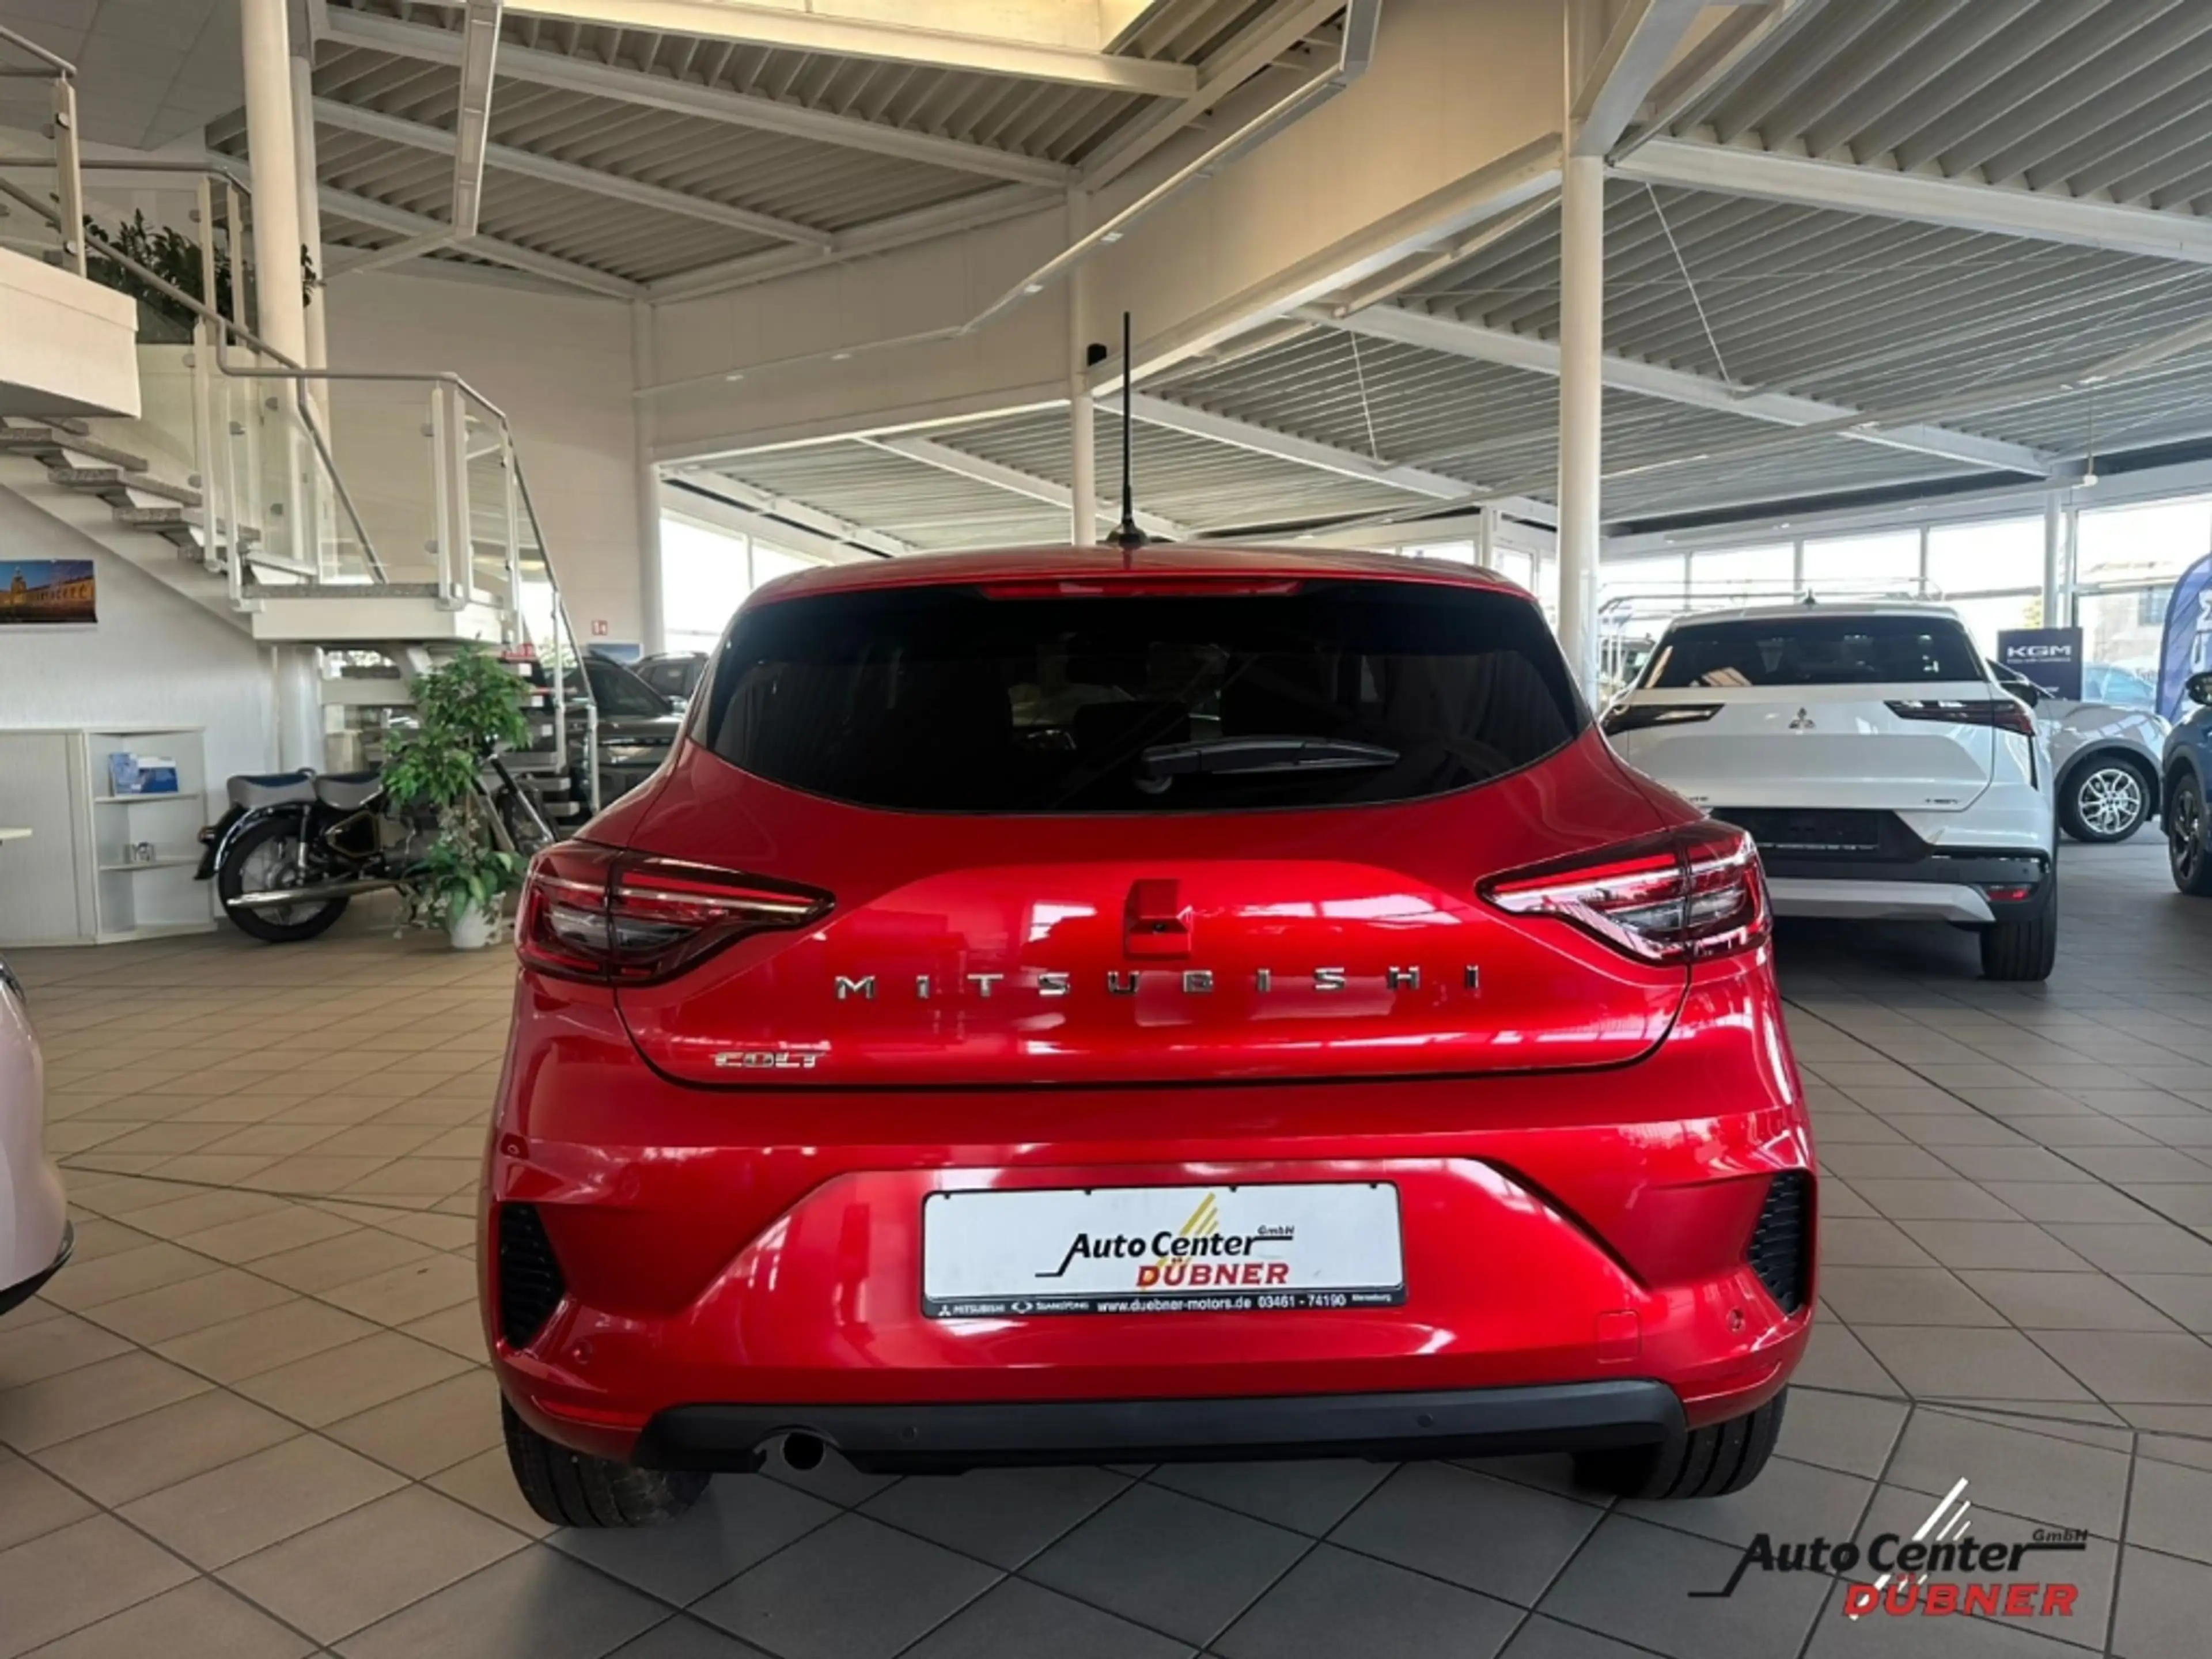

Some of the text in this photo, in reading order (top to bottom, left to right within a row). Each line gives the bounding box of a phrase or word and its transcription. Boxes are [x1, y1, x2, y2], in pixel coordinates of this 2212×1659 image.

[2008, 645, 2071, 657] KGM
[834, 965, 1479, 1000] MITSUBISHI
[712, 1051, 826, 1069] COLT
[1061, 1225, 1295, 1263] Auto Center GmbH
[1137, 1257, 1290, 1287] DÜBNER
[1097, 1296, 1252, 1312] www.duebner-motors.de
[1257, 1295, 1296, 1308] 03461
[1307, 1294, 1347, 1308] 74190
